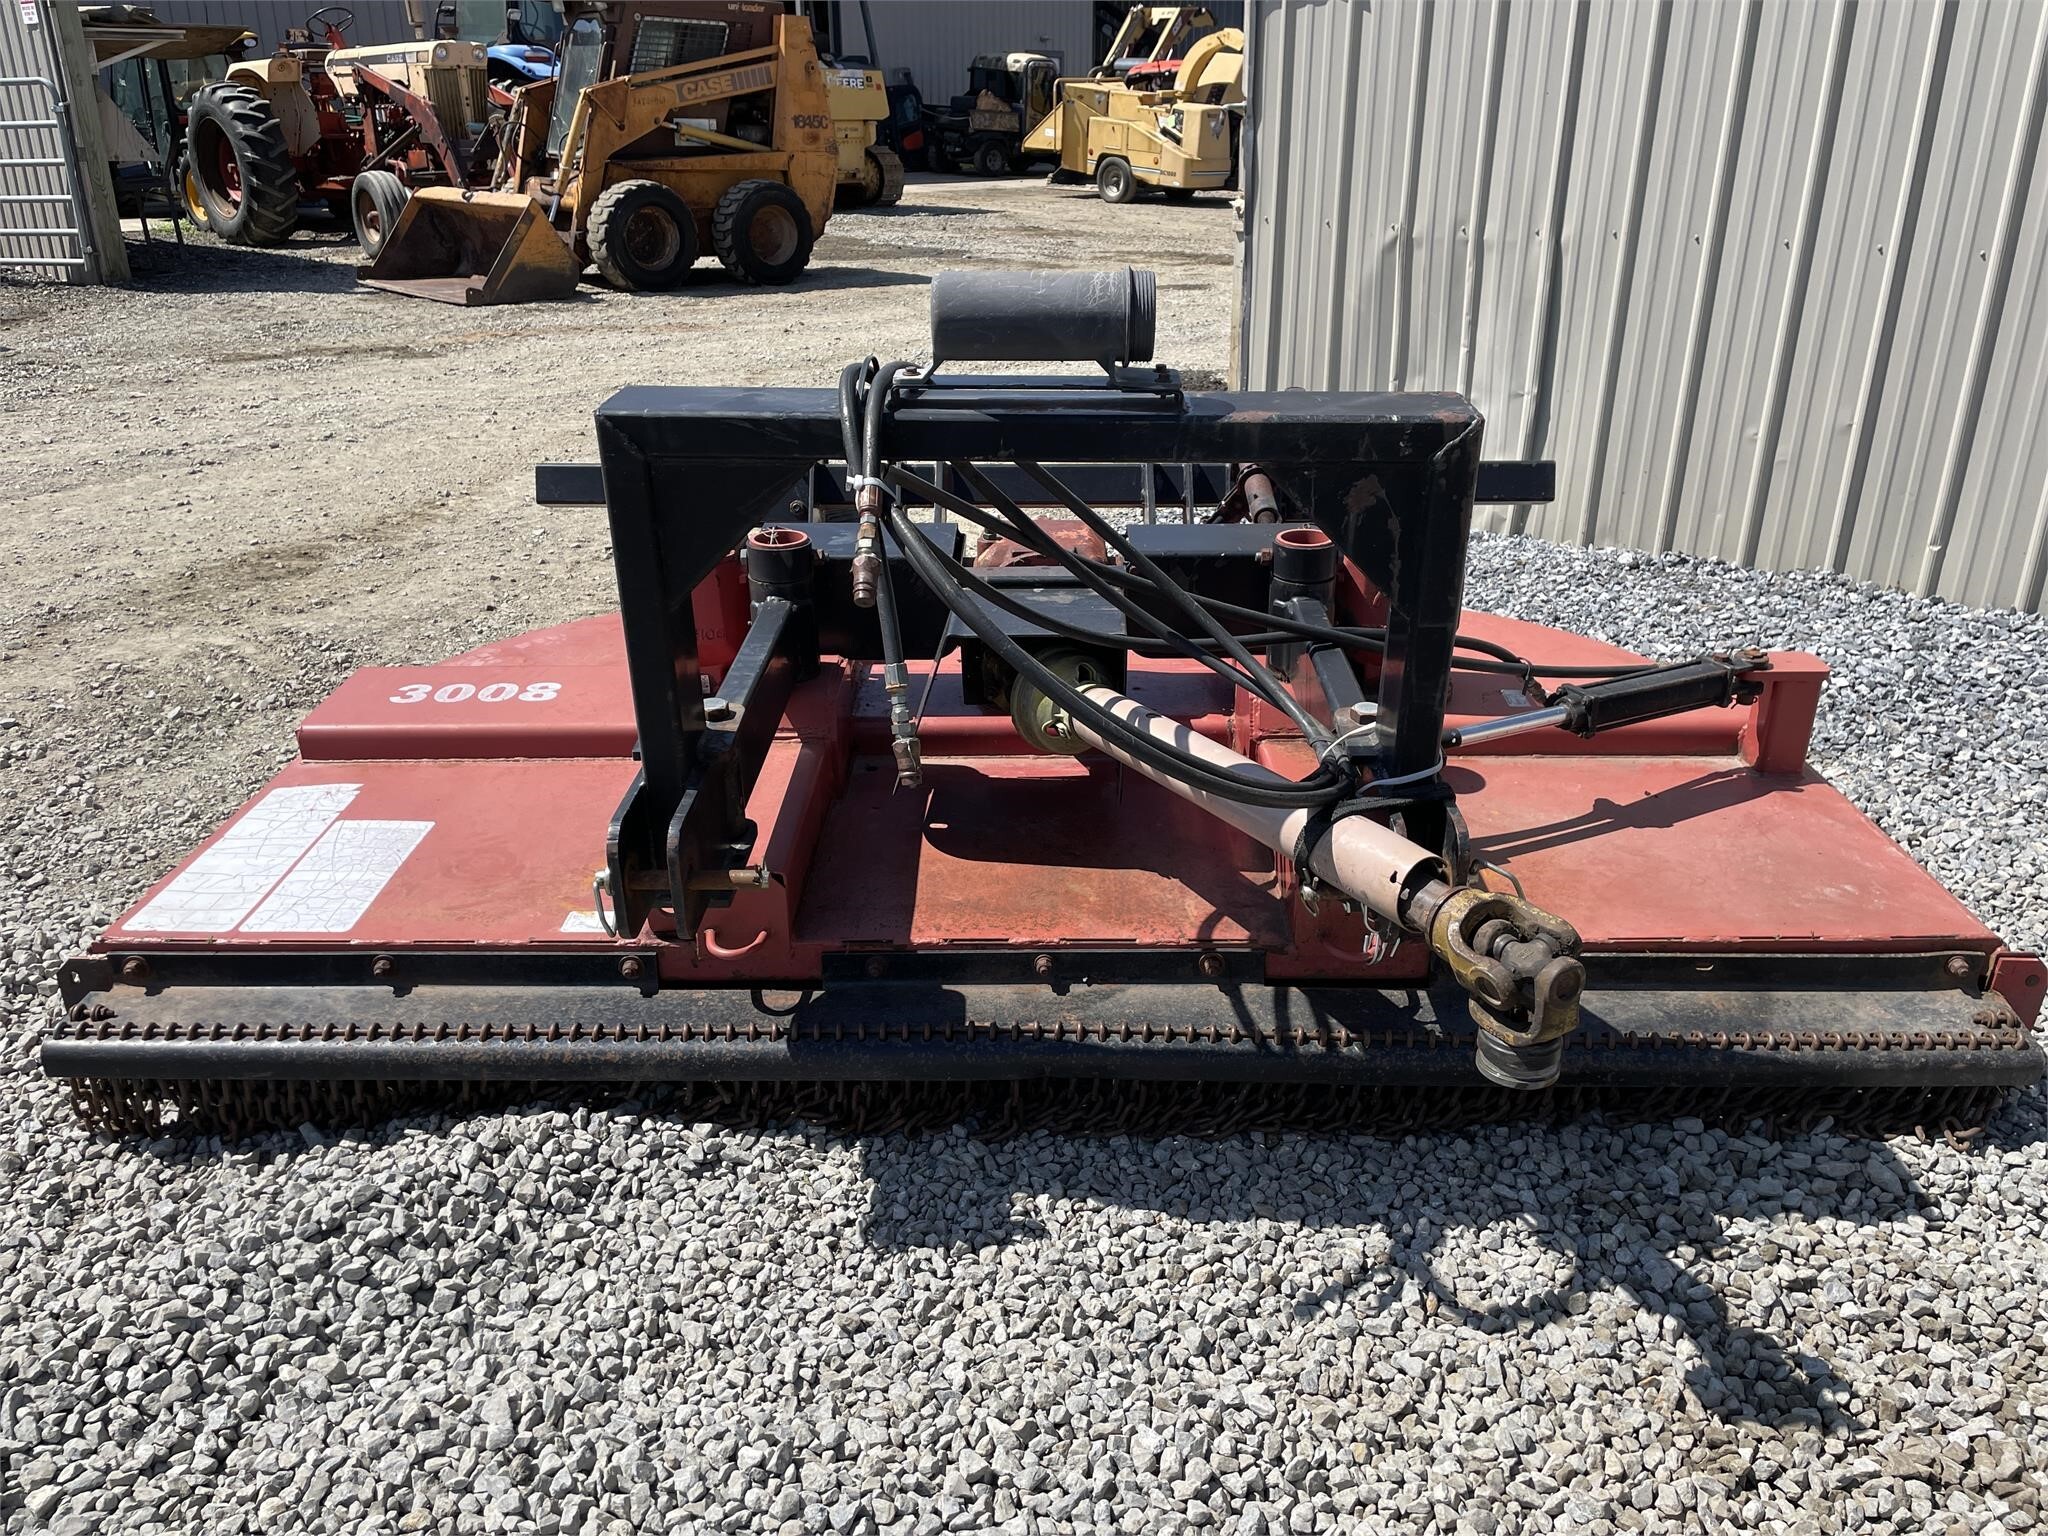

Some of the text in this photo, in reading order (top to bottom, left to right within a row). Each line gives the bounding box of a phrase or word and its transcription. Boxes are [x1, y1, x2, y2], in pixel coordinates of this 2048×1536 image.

[386, 54, 404, 63] CASE
[682, 75, 733, 99] CASE
[792, 115, 829, 129] 1845C
[389, 682, 562, 704] 3008
